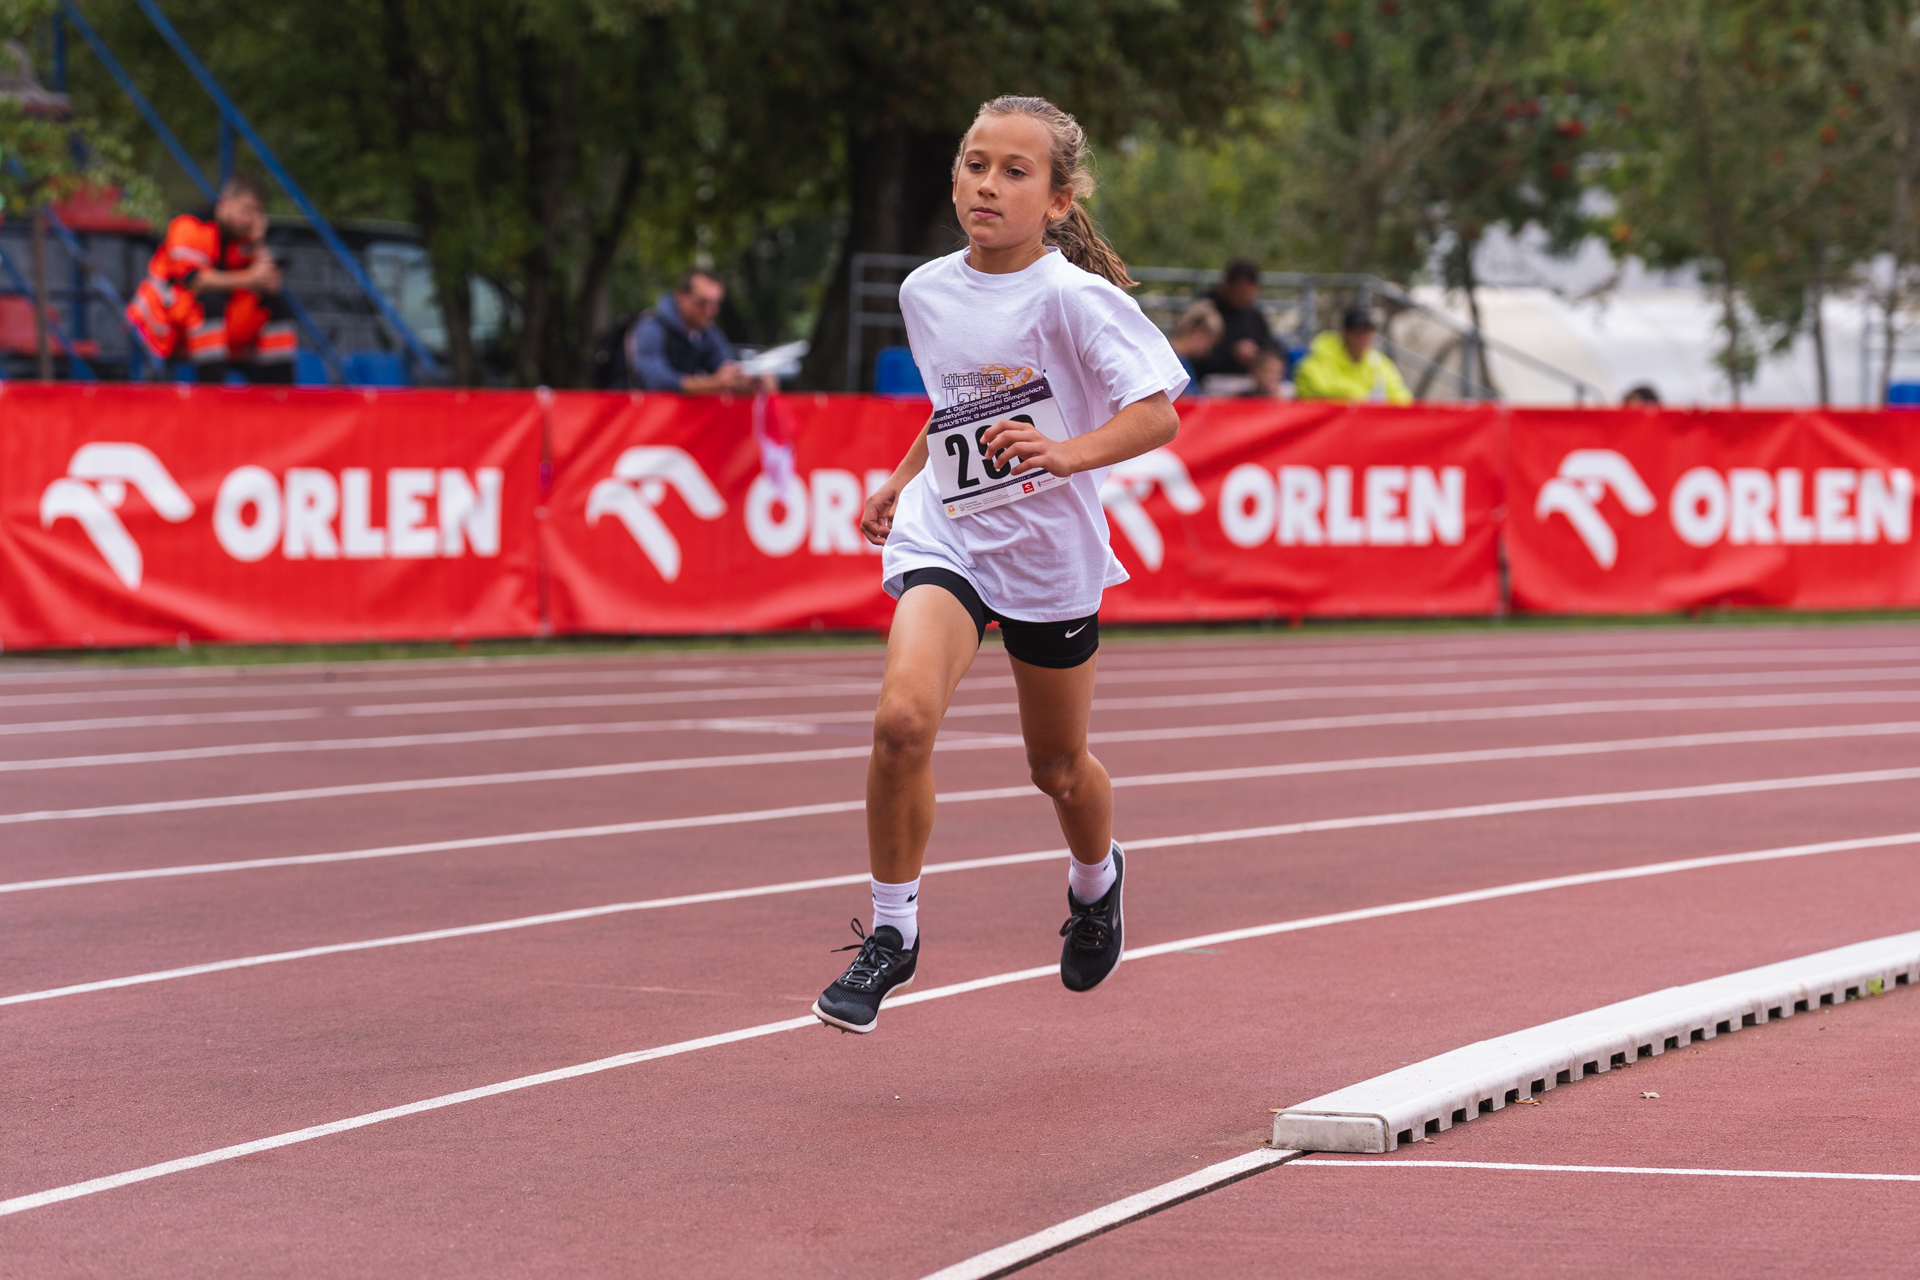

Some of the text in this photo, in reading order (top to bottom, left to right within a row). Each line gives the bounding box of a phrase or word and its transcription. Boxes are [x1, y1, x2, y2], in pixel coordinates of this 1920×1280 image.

[941, 372, 1006, 388] Lekkoatletyczne
[944, 414, 1036, 490] 29
[213, 464, 502, 561] ORLEN
[1218, 463, 1465, 547] ORLEN
[1670, 466, 1914, 548] ORLEN
